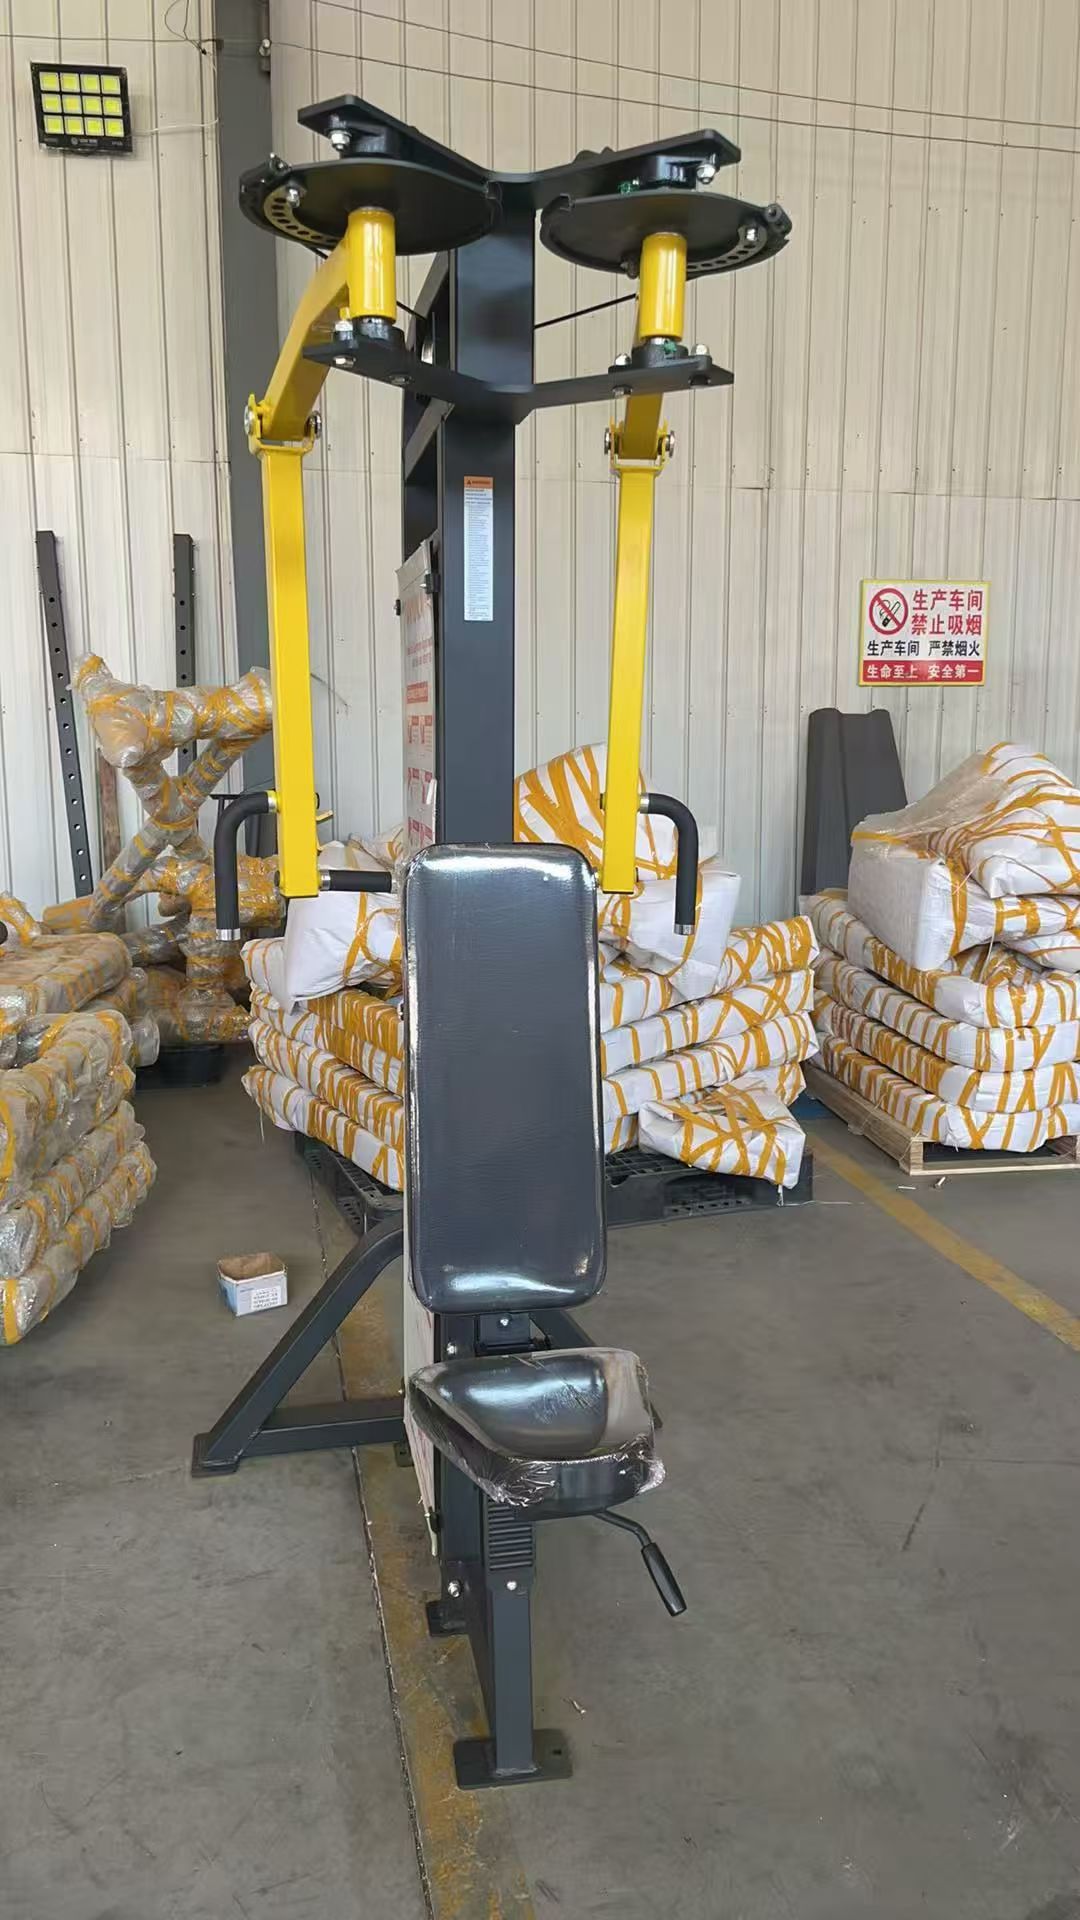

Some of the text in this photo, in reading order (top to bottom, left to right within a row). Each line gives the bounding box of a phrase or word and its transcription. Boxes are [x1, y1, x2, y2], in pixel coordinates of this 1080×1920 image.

[912, 588, 983, 612] 生产车间
[911, 614, 982, 636] 禁止吸烟
[867, 640, 980, 657] 生产车间 严禁烟火
[867, 664, 979, 680] 生命至上 安全第一
